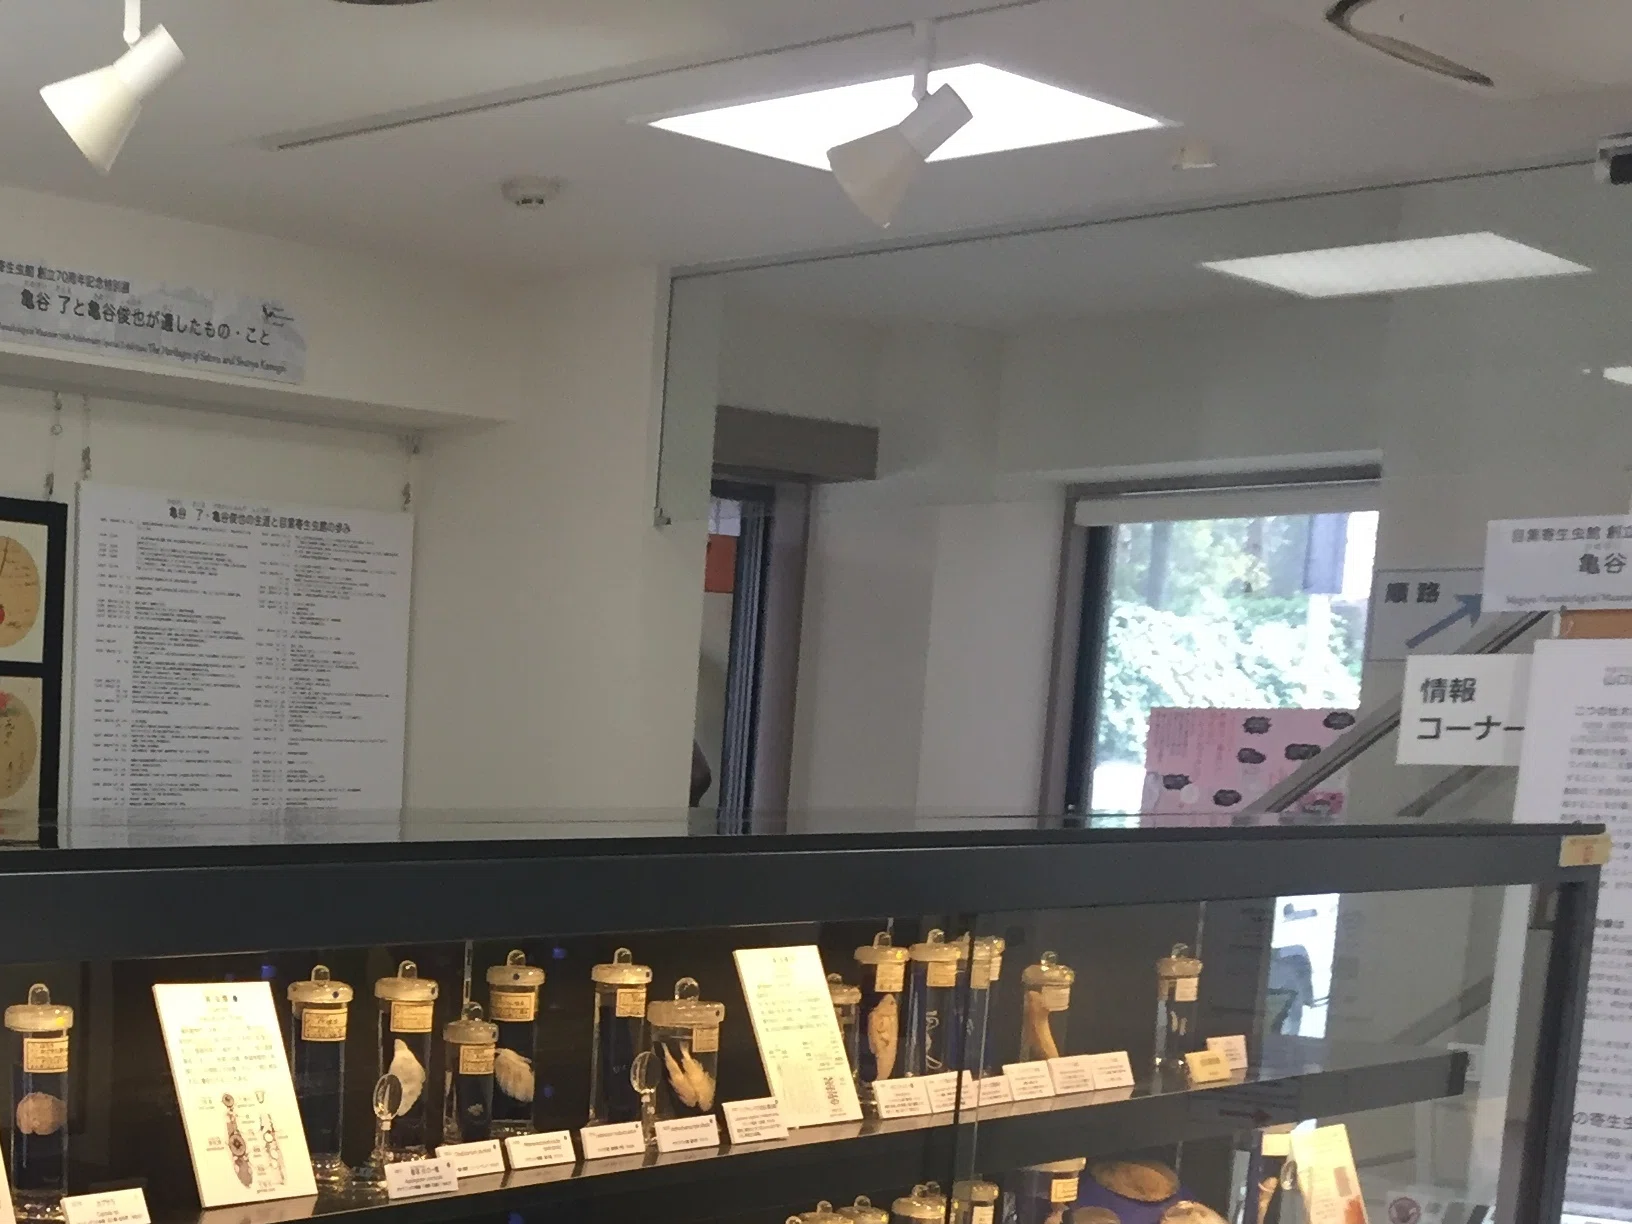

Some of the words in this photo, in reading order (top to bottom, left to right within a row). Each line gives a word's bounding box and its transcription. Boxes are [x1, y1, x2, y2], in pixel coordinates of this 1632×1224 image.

[1420, 676, 1478, 705] 情報
[1417, 714, 1526, 741] コーナー
